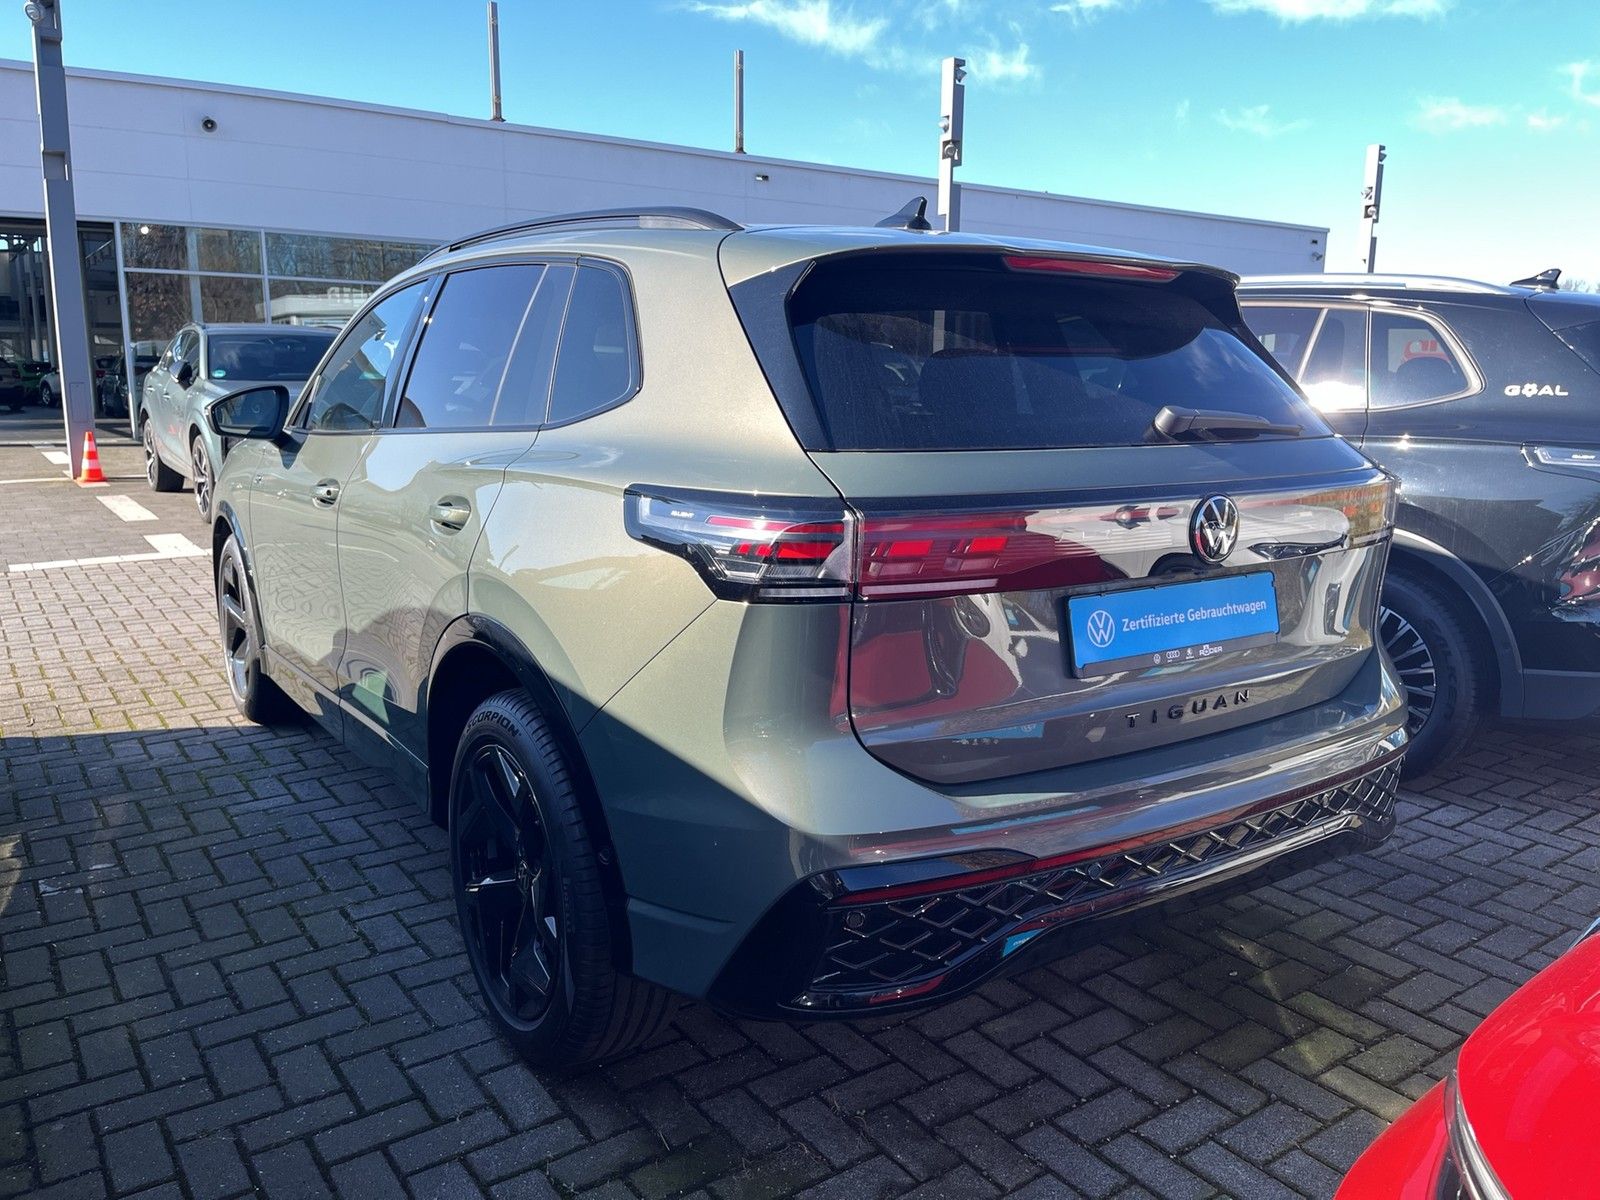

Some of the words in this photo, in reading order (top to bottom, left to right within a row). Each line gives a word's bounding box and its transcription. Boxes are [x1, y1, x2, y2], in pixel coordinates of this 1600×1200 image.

[1504, 383, 1569, 398] GOAL
[1122, 612, 1186, 632] Zertifizierte
[1187, 600, 1267, 621] Gebrauchtwagen
[1125, 689, 1250, 728] TIGUAN
[466, 710, 520, 738] SCORPION
